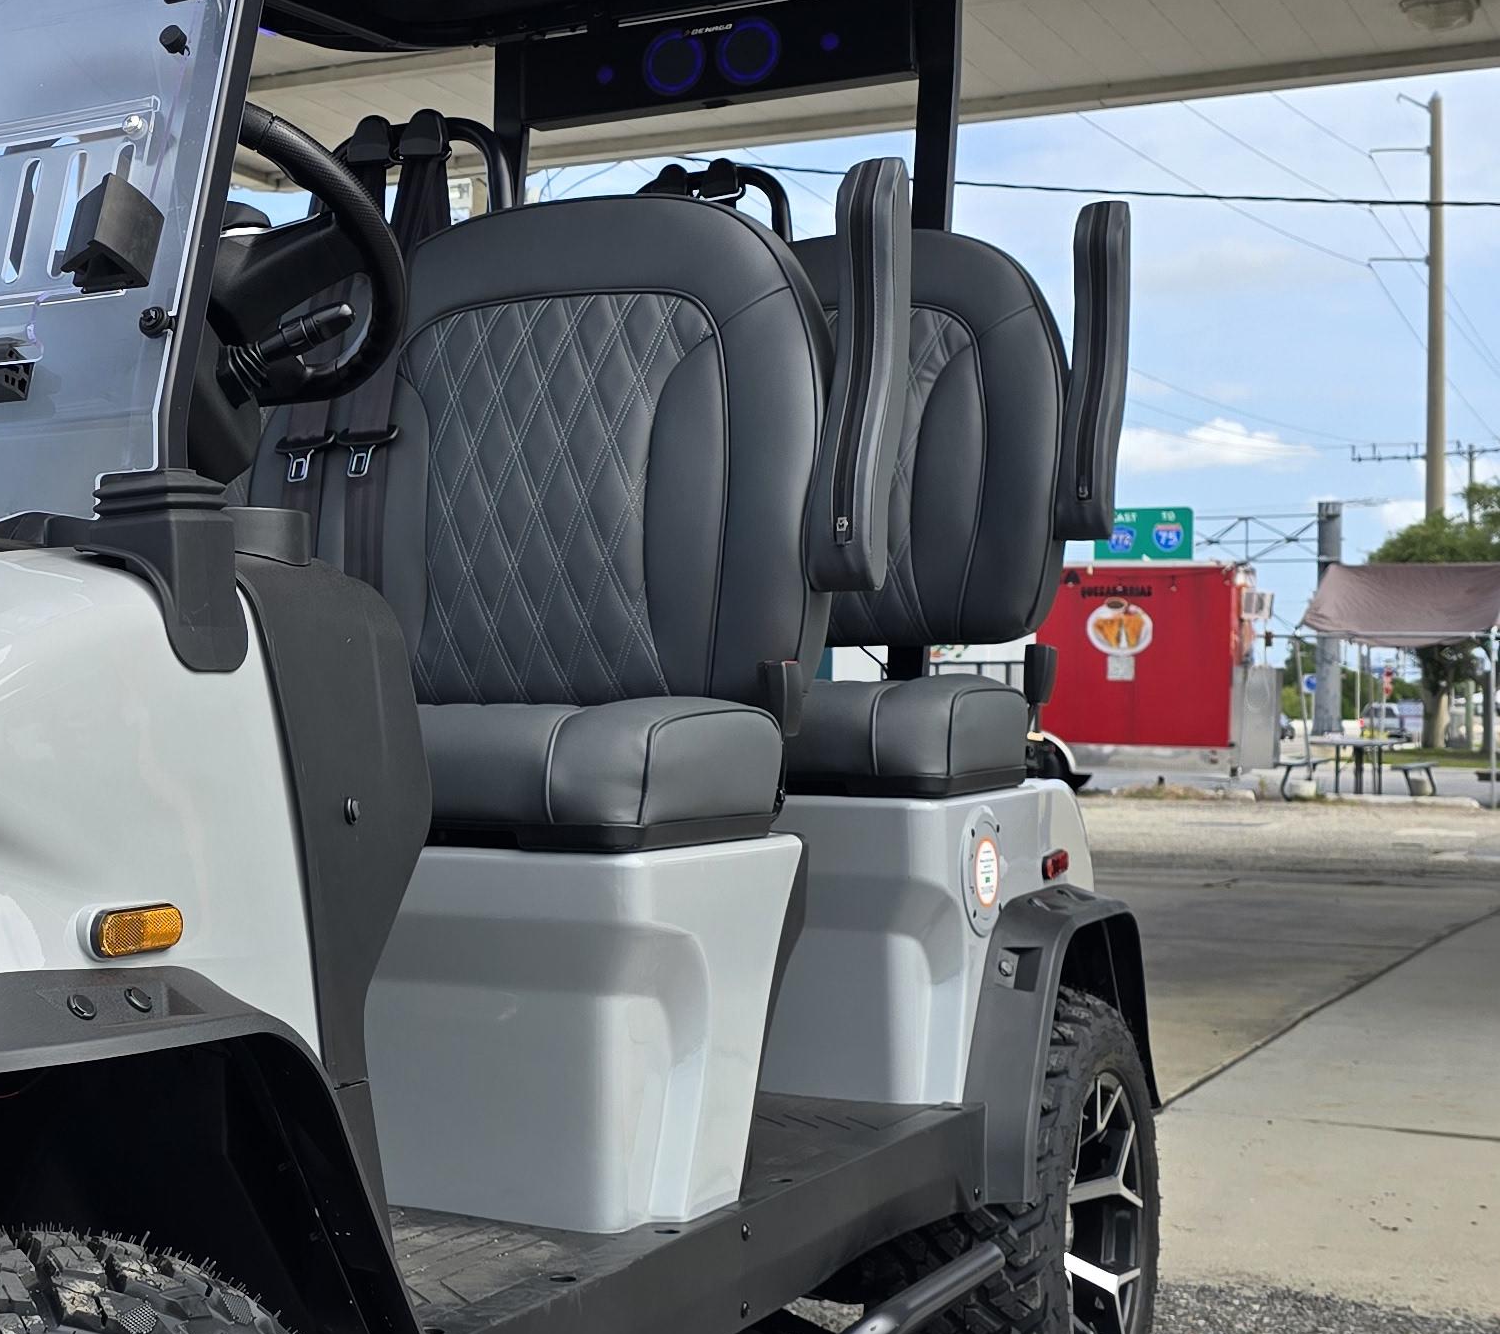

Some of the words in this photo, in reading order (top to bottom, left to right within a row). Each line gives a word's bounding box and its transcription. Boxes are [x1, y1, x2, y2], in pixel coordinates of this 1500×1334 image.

[690, 23, 733, 36] DENAGO
[1161, 510, 1176, 522] TO
[1158, 530, 1179, 546] 75
